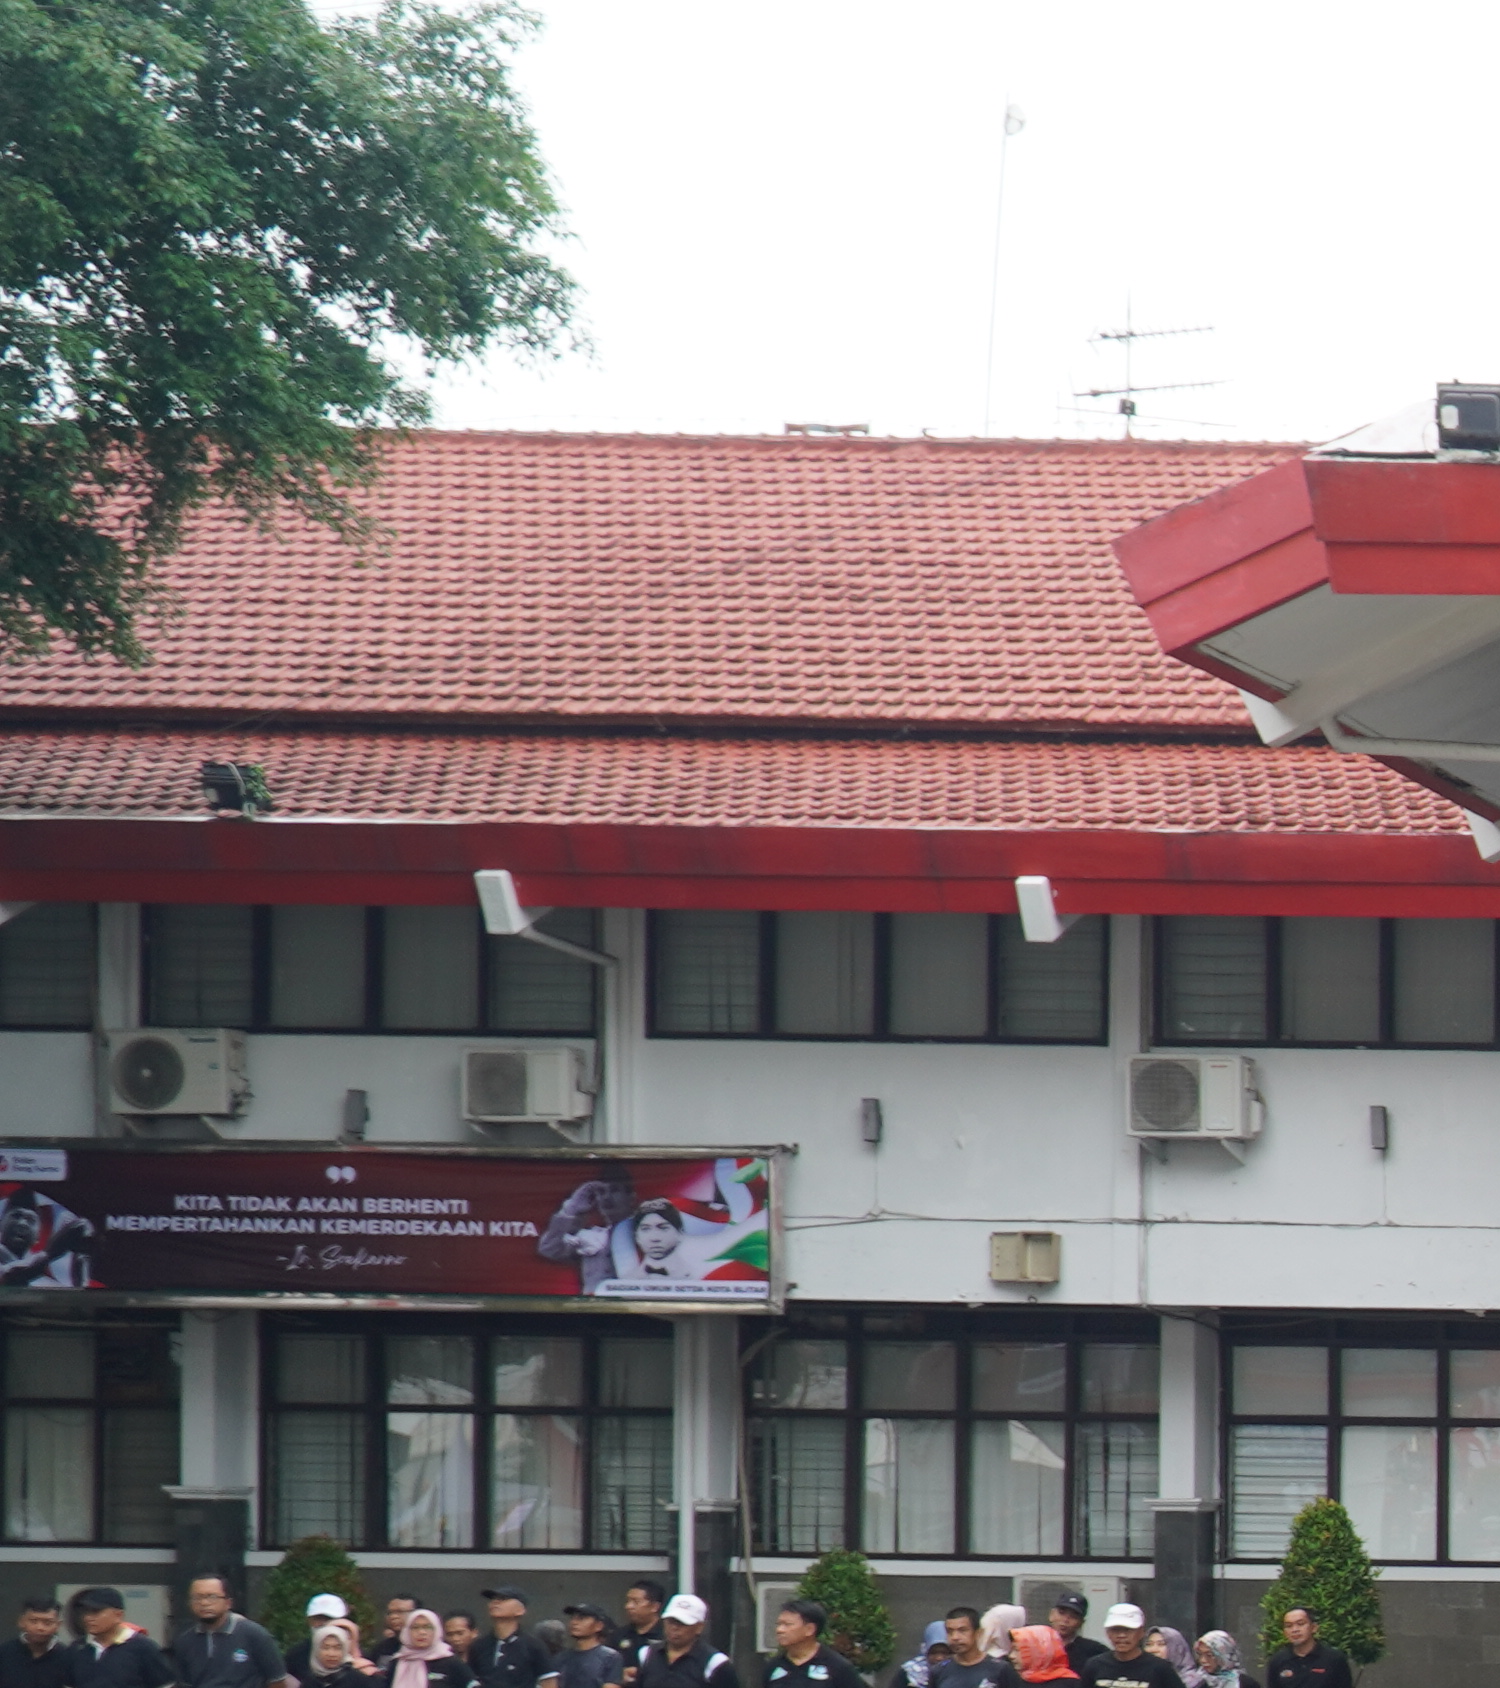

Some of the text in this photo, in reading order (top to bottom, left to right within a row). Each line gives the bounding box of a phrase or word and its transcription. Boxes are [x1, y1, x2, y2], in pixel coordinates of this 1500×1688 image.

[174, 1195, 470, 1215] KITA TIDAK AKAN BERHENTI
[105, 1214, 539, 1238] MEMPERTAHANKAN KEMERDEKAAN KITA
